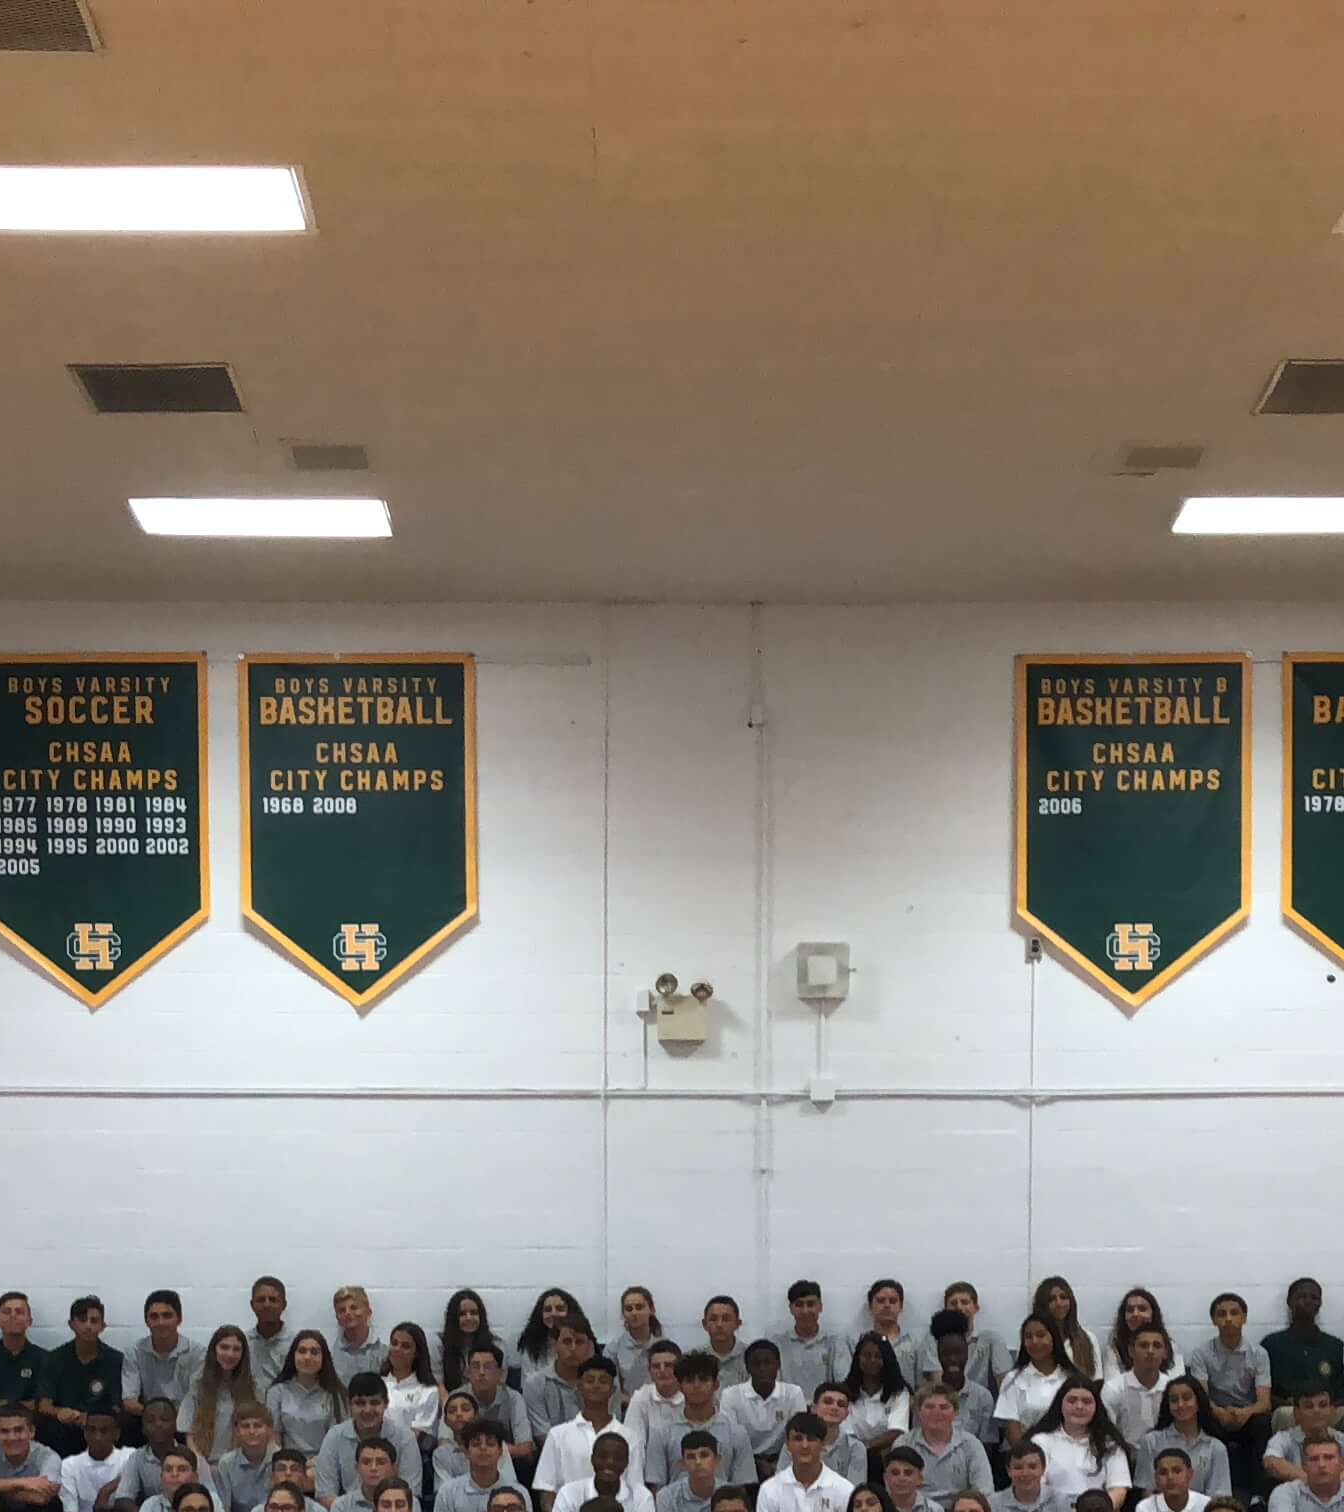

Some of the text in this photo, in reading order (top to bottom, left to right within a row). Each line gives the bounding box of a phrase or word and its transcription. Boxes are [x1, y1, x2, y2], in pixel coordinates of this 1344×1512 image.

[9, 677, 169, 693] BOYS VARSITY
[275, 678, 435, 694] BOYS VARSITY
[1041, 679, 1094, 694] BOYS
[1109, 678, 1202, 694] VARSITY
[26, 696, 154, 724] SOCCER
[260, 697, 452, 724] BASKETBALL
[1039, 696, 1230, 724] BASKETBALL
[49, 742, 130, 762] CHSAA
[317, 743, 397, 763] CHSAA
[1093, 743, 1174, 763] CHSAA
[4, 770, 177, 790] CITY CHAMPS
[271, 770, 443, 790] CITY CHAMPS
[1047, 769, 1220, 791] CITY CHAMPS
[47, 797, 87, 813] 1978
[96, 797, 134, 813] 1981
[146, 797, 186, 812] 1984
[263, 797, 356, 813] 1968 2008
[1039, 798, 1081, 814] 2006
[1304, 796, 1344, 812] 1978
[47, 817, 87, 833] 1989
[96, 818, 136, 833] 1990
[146, 818, 186, 833] 1993
[48, 838, 87, 854] 1995
[96, 838, 139, 854] 2000
[146, 838, 188, 854] 2002
